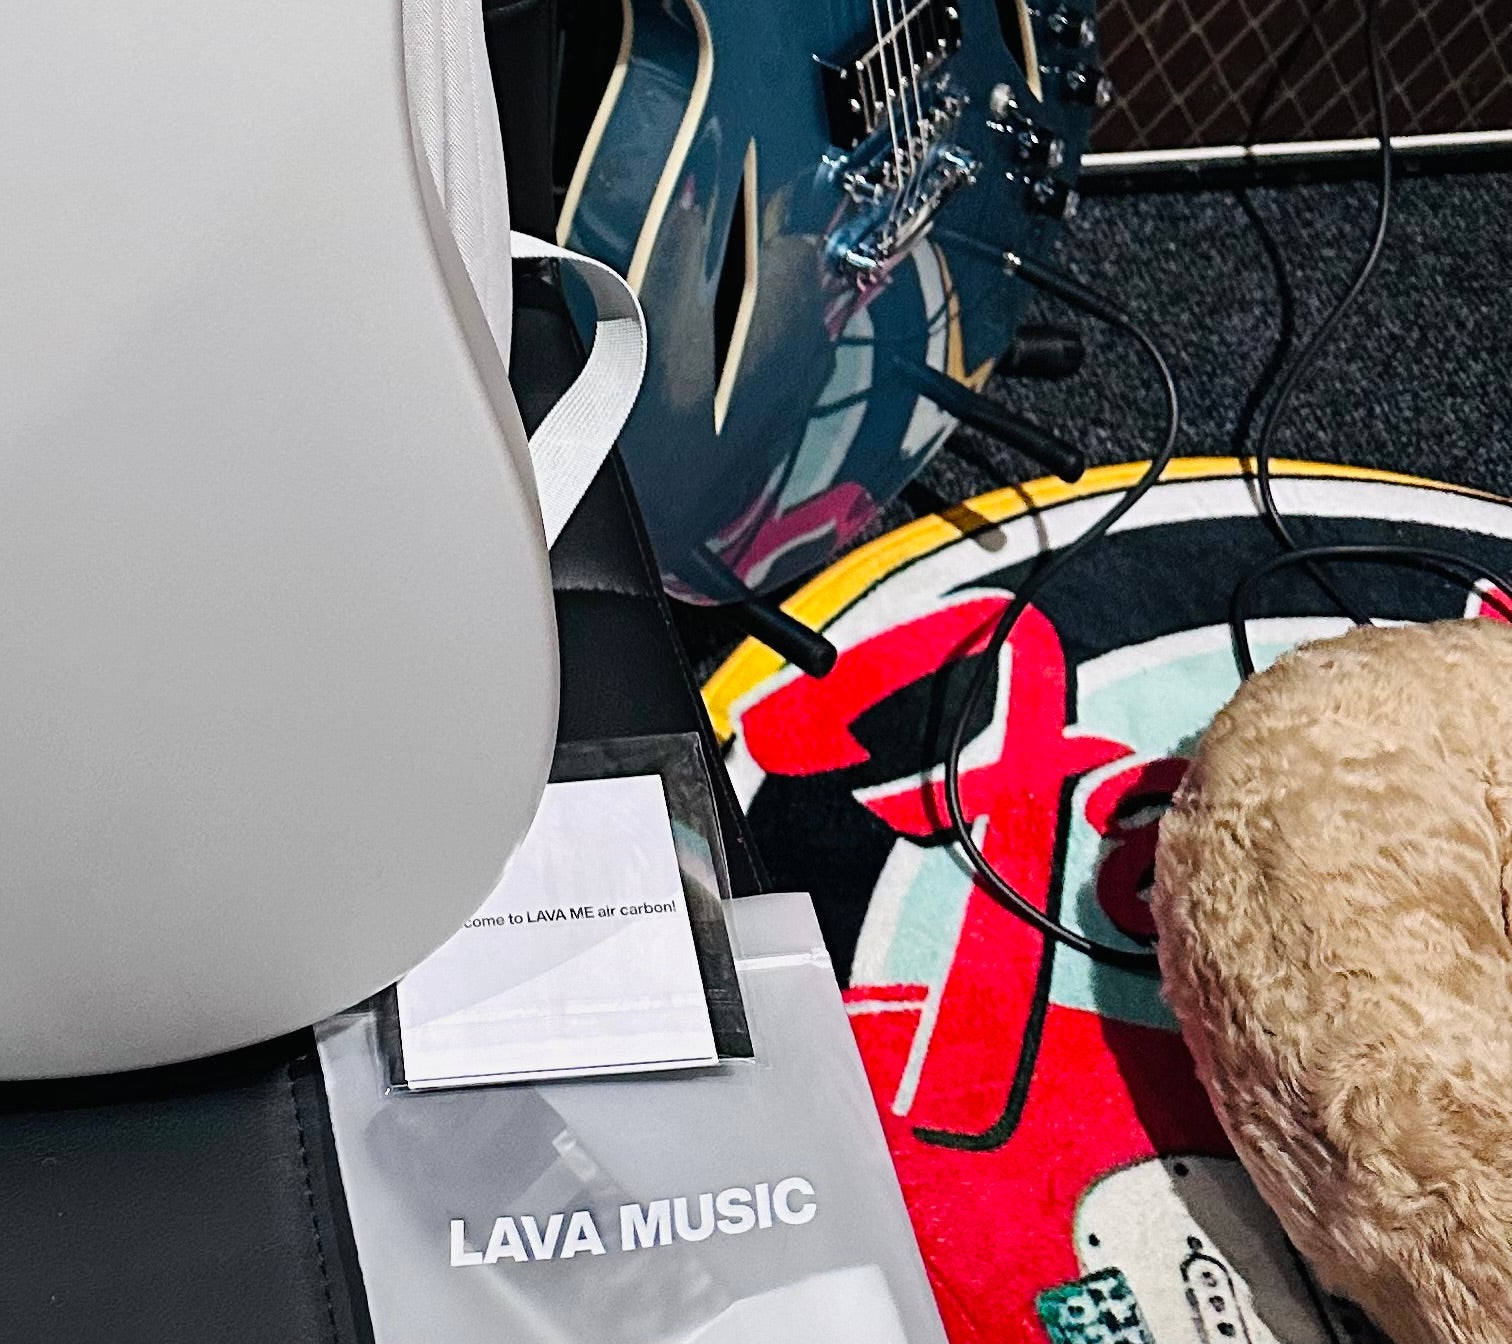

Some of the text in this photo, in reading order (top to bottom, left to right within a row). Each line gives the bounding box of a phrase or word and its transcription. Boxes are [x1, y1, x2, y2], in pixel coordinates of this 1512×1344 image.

[508, 913, 524, 925] to
[527, 908, 568, 923] LAVA
[570, 905, 595, 920] ME
[597, 904, 616, 918] air
[620, 900, 677, 917] carbon!
[449, 1176, 818, 1268] LAVA MUSIC
